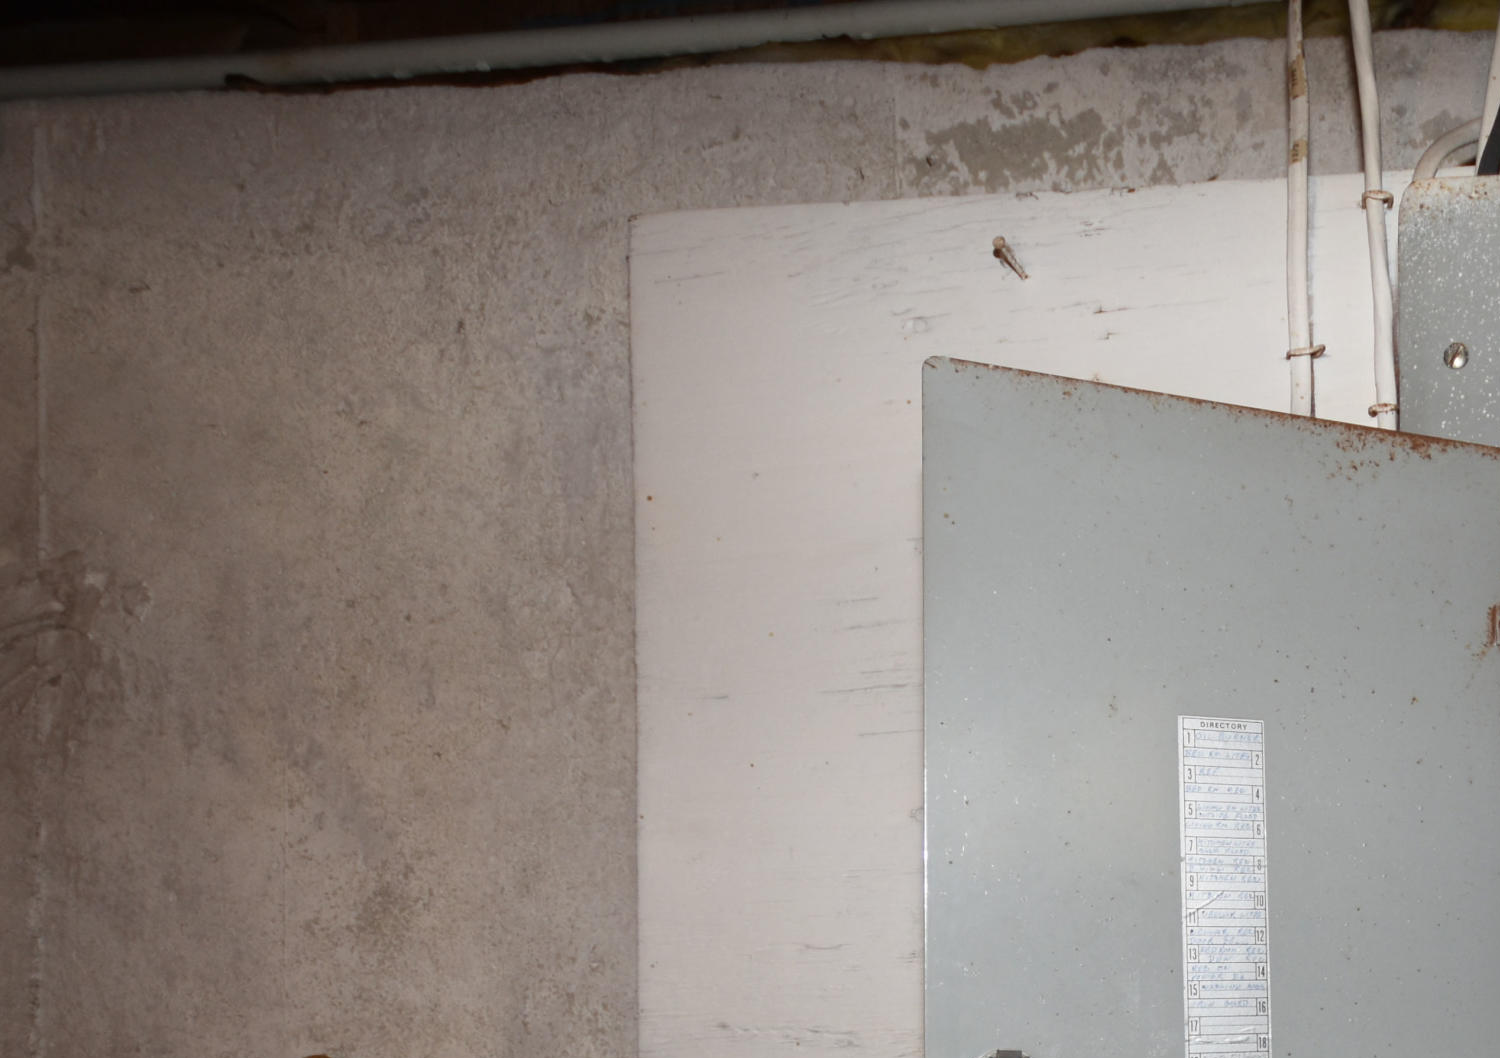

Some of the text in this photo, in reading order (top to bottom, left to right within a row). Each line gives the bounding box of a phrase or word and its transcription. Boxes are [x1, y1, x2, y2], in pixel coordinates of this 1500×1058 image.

[1200, 721, 1248, 730] DIRECTORY
[1256, 895, 1264, 907] 10
[1189, 911, 1196, 924] 11
[1256, 929, 1264, 943] 12
[1189, 948, 1197, 961] 13
[1257, 965, 1266, 978] 14
[1189, 983, 1198, 997] 15
[1258, 1000, 1267, 1014] 16
[1190, 1019, 1198, 1033] 17
[1258, 1037, 1267, 1049] 18
